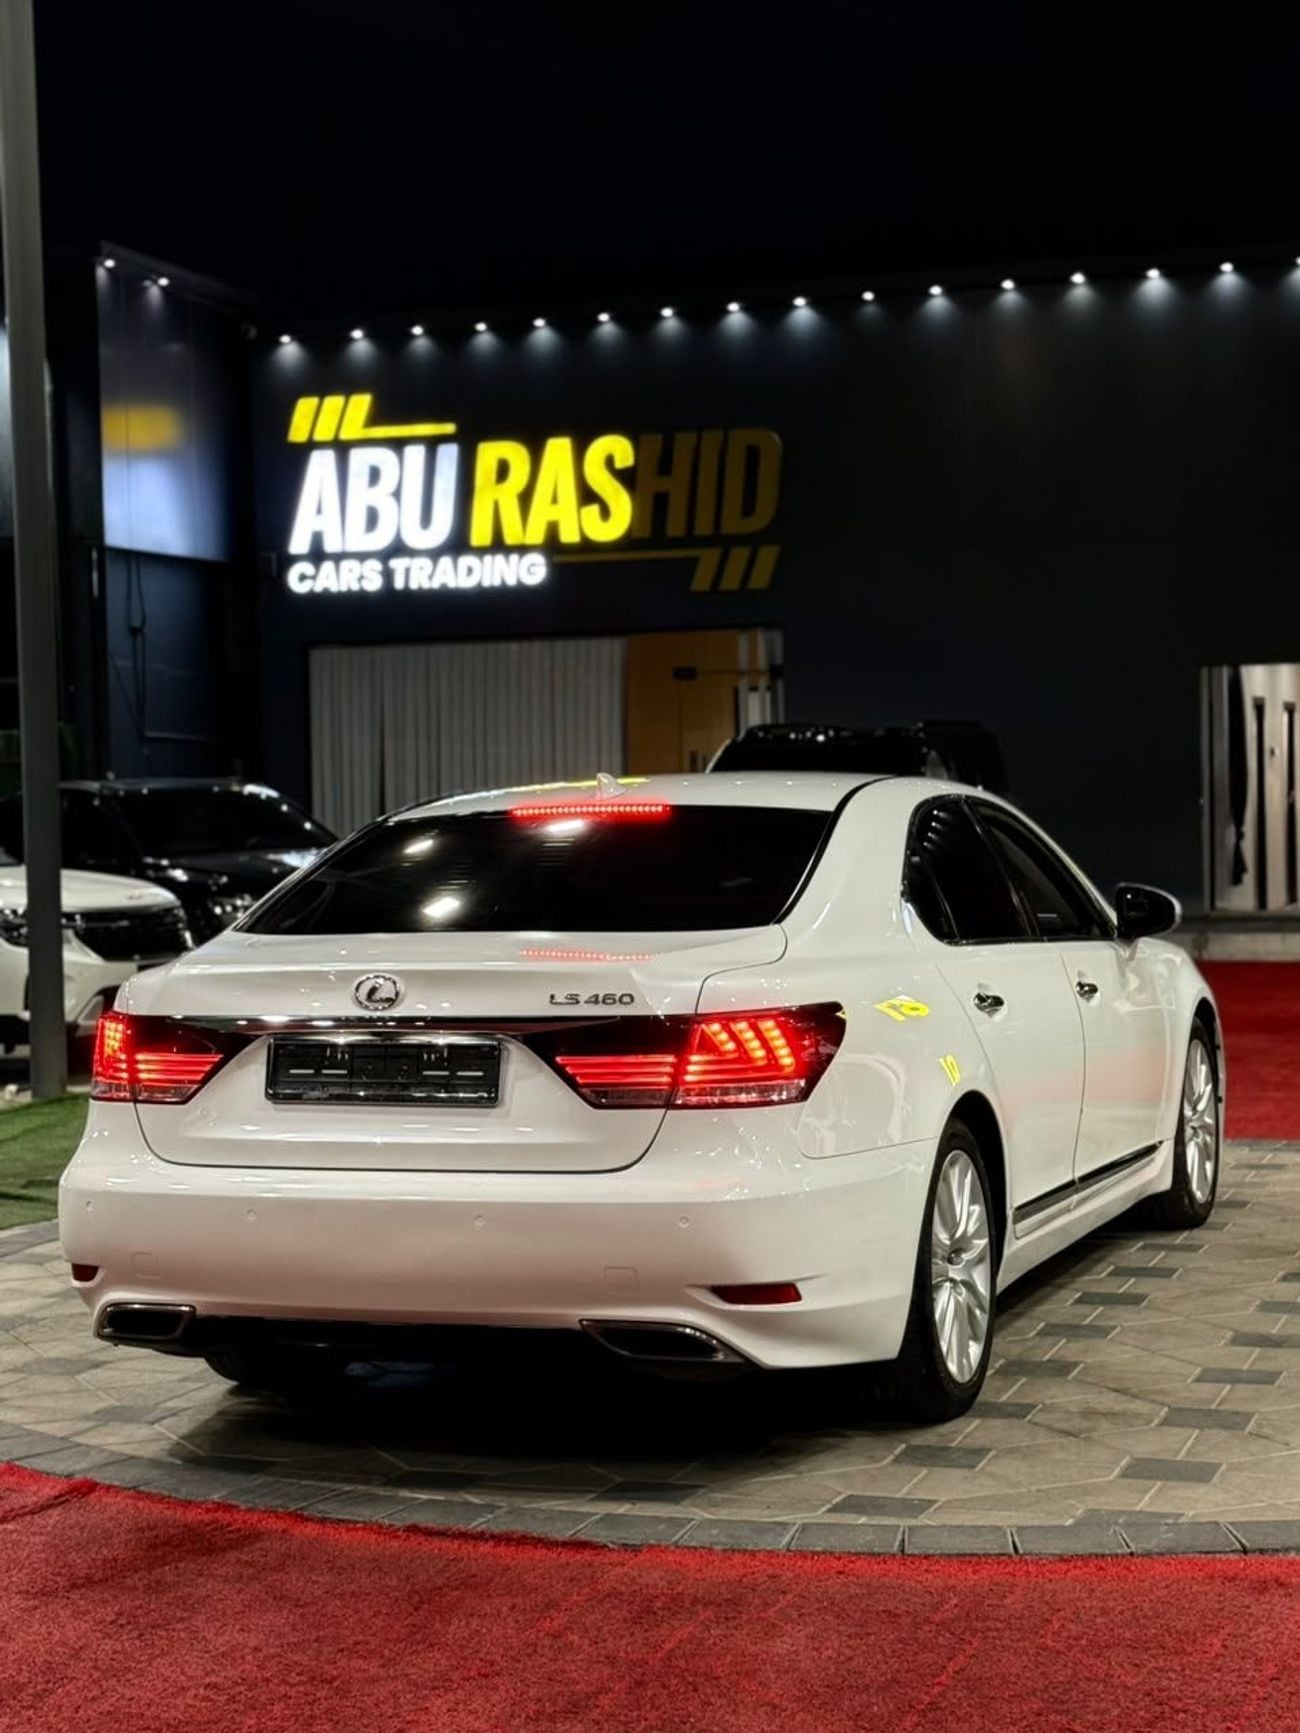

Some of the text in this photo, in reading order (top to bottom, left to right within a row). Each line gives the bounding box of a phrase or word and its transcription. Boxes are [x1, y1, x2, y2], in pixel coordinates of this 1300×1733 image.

[289, 429, 783, 554] ABU RASHID
[287, 554, 547, 593] CARS TRADING
